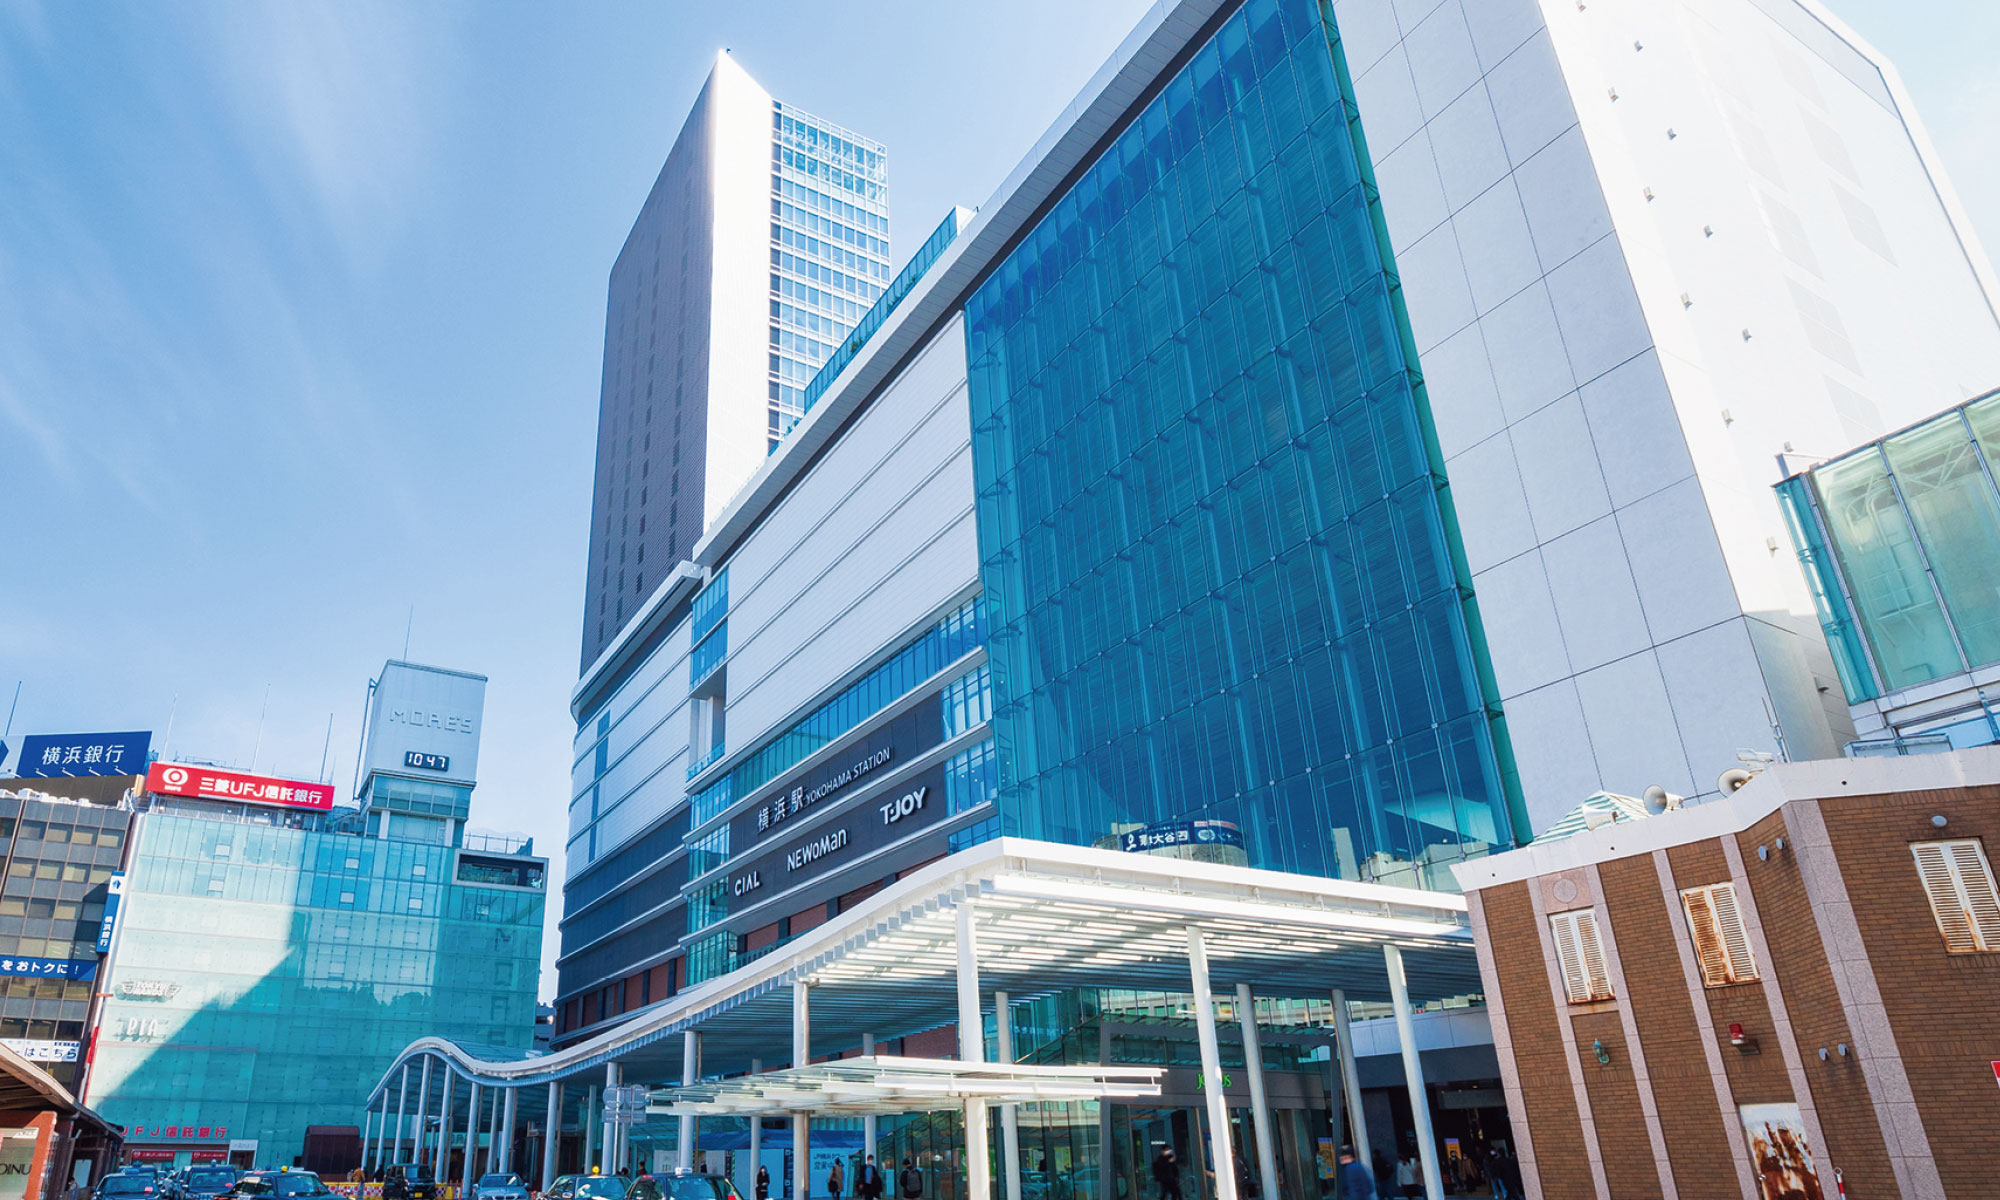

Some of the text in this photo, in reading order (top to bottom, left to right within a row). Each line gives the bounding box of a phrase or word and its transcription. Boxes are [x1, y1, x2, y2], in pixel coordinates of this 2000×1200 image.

[42, 744, 125, 765] 横浜銀行
[199, 776, 323, 804] 三菱UFJ信託銀行
[758, 747, 890, 832] 横浜駅 YOKOHAMA STATION
[734, 871, 761, 896] CIAL
